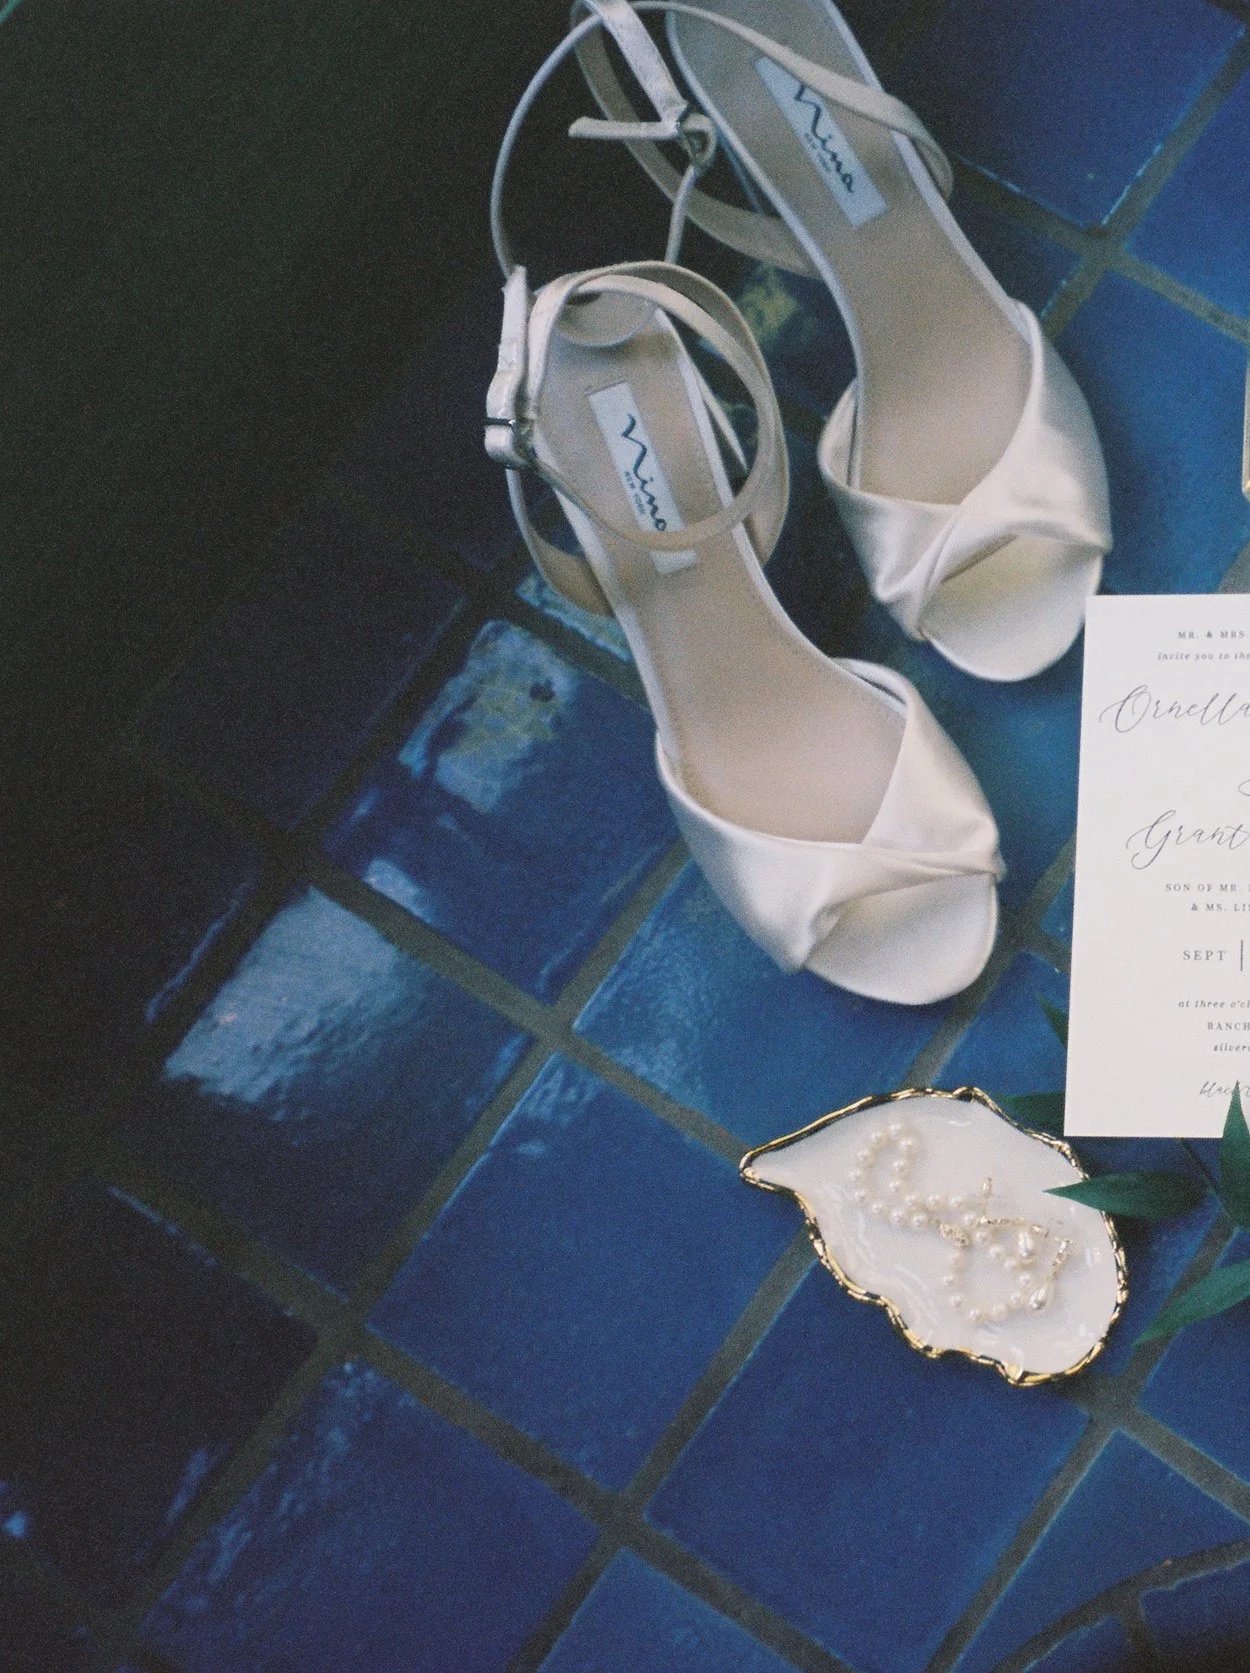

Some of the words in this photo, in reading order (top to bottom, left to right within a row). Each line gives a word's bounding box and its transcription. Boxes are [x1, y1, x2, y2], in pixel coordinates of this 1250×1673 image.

[794, 83, 854, 194] Nina
[620, 413, 668, 532] Nina
[1158, 652, 1190, 660] invite
[1195, 653, 1213, 662] you
[1219, 652, 1229, 660] to
[1235, 651, 1250, 660] the
[1165, 884, 1191, 892] SON
[1197, 884, 1213, 892] OF
[1205, 904, 1228, 912] MS.
[1183, 950, 1226, 961] SEPT
[1178, 1000, 1189, 1008] at
[1195, 1000, 1225, 1008] three
[1200, 1081, 1238, 1097] blac
